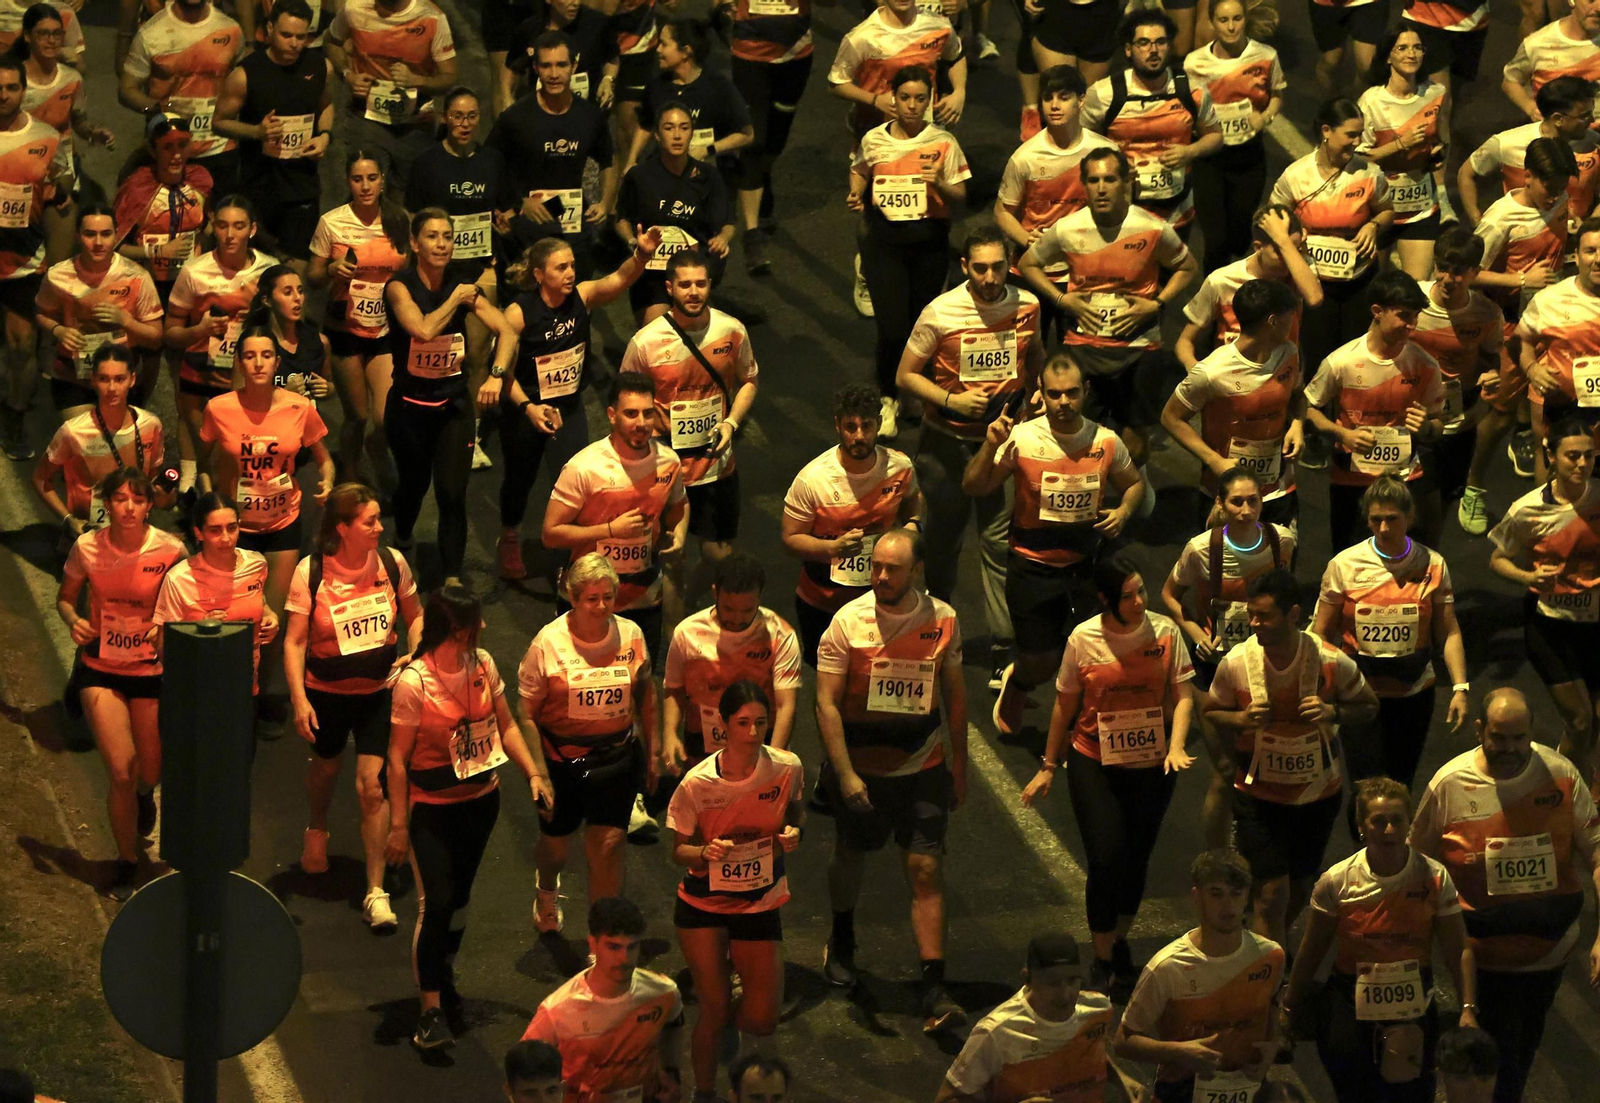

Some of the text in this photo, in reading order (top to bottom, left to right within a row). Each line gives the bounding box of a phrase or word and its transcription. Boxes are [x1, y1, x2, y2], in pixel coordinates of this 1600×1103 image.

[544, 138, 579, 154] FLOW
[449, 181, 486, 196] FLOW
[1389, 184, 1428, 201] 13494
[2, 201, 26, 214] 964
[879, 193, 919, 208] 24501
[454, 230, 485, 247] 4841
[416, 352, 458, 368] 11217
[967, 350, 1010, 368] 14685
[677, 414, 718, 435] 23805
[241, 458, 274, 472] TUR
[244, 493, 286, 511] 21315
[1047, 492, 1092, 509] 13922
[603, 545, 648, 561] 23968
[837, 556, 872, 573] 2461
[343, 614, 389, 639] 18778
[1362, 625, 1411, 643] 22209
[576, 688, 623, 706] 18729
[876, 680, 924, 699] 19014
[1107, 728, 1157, 749] 11664
[1266, 753, 1315, 771] 11665
[721, 860, 761, 879] 6479
[1494, 857, 1547, 879] 16021
[1363, 983, 1415, 1004] 18099
